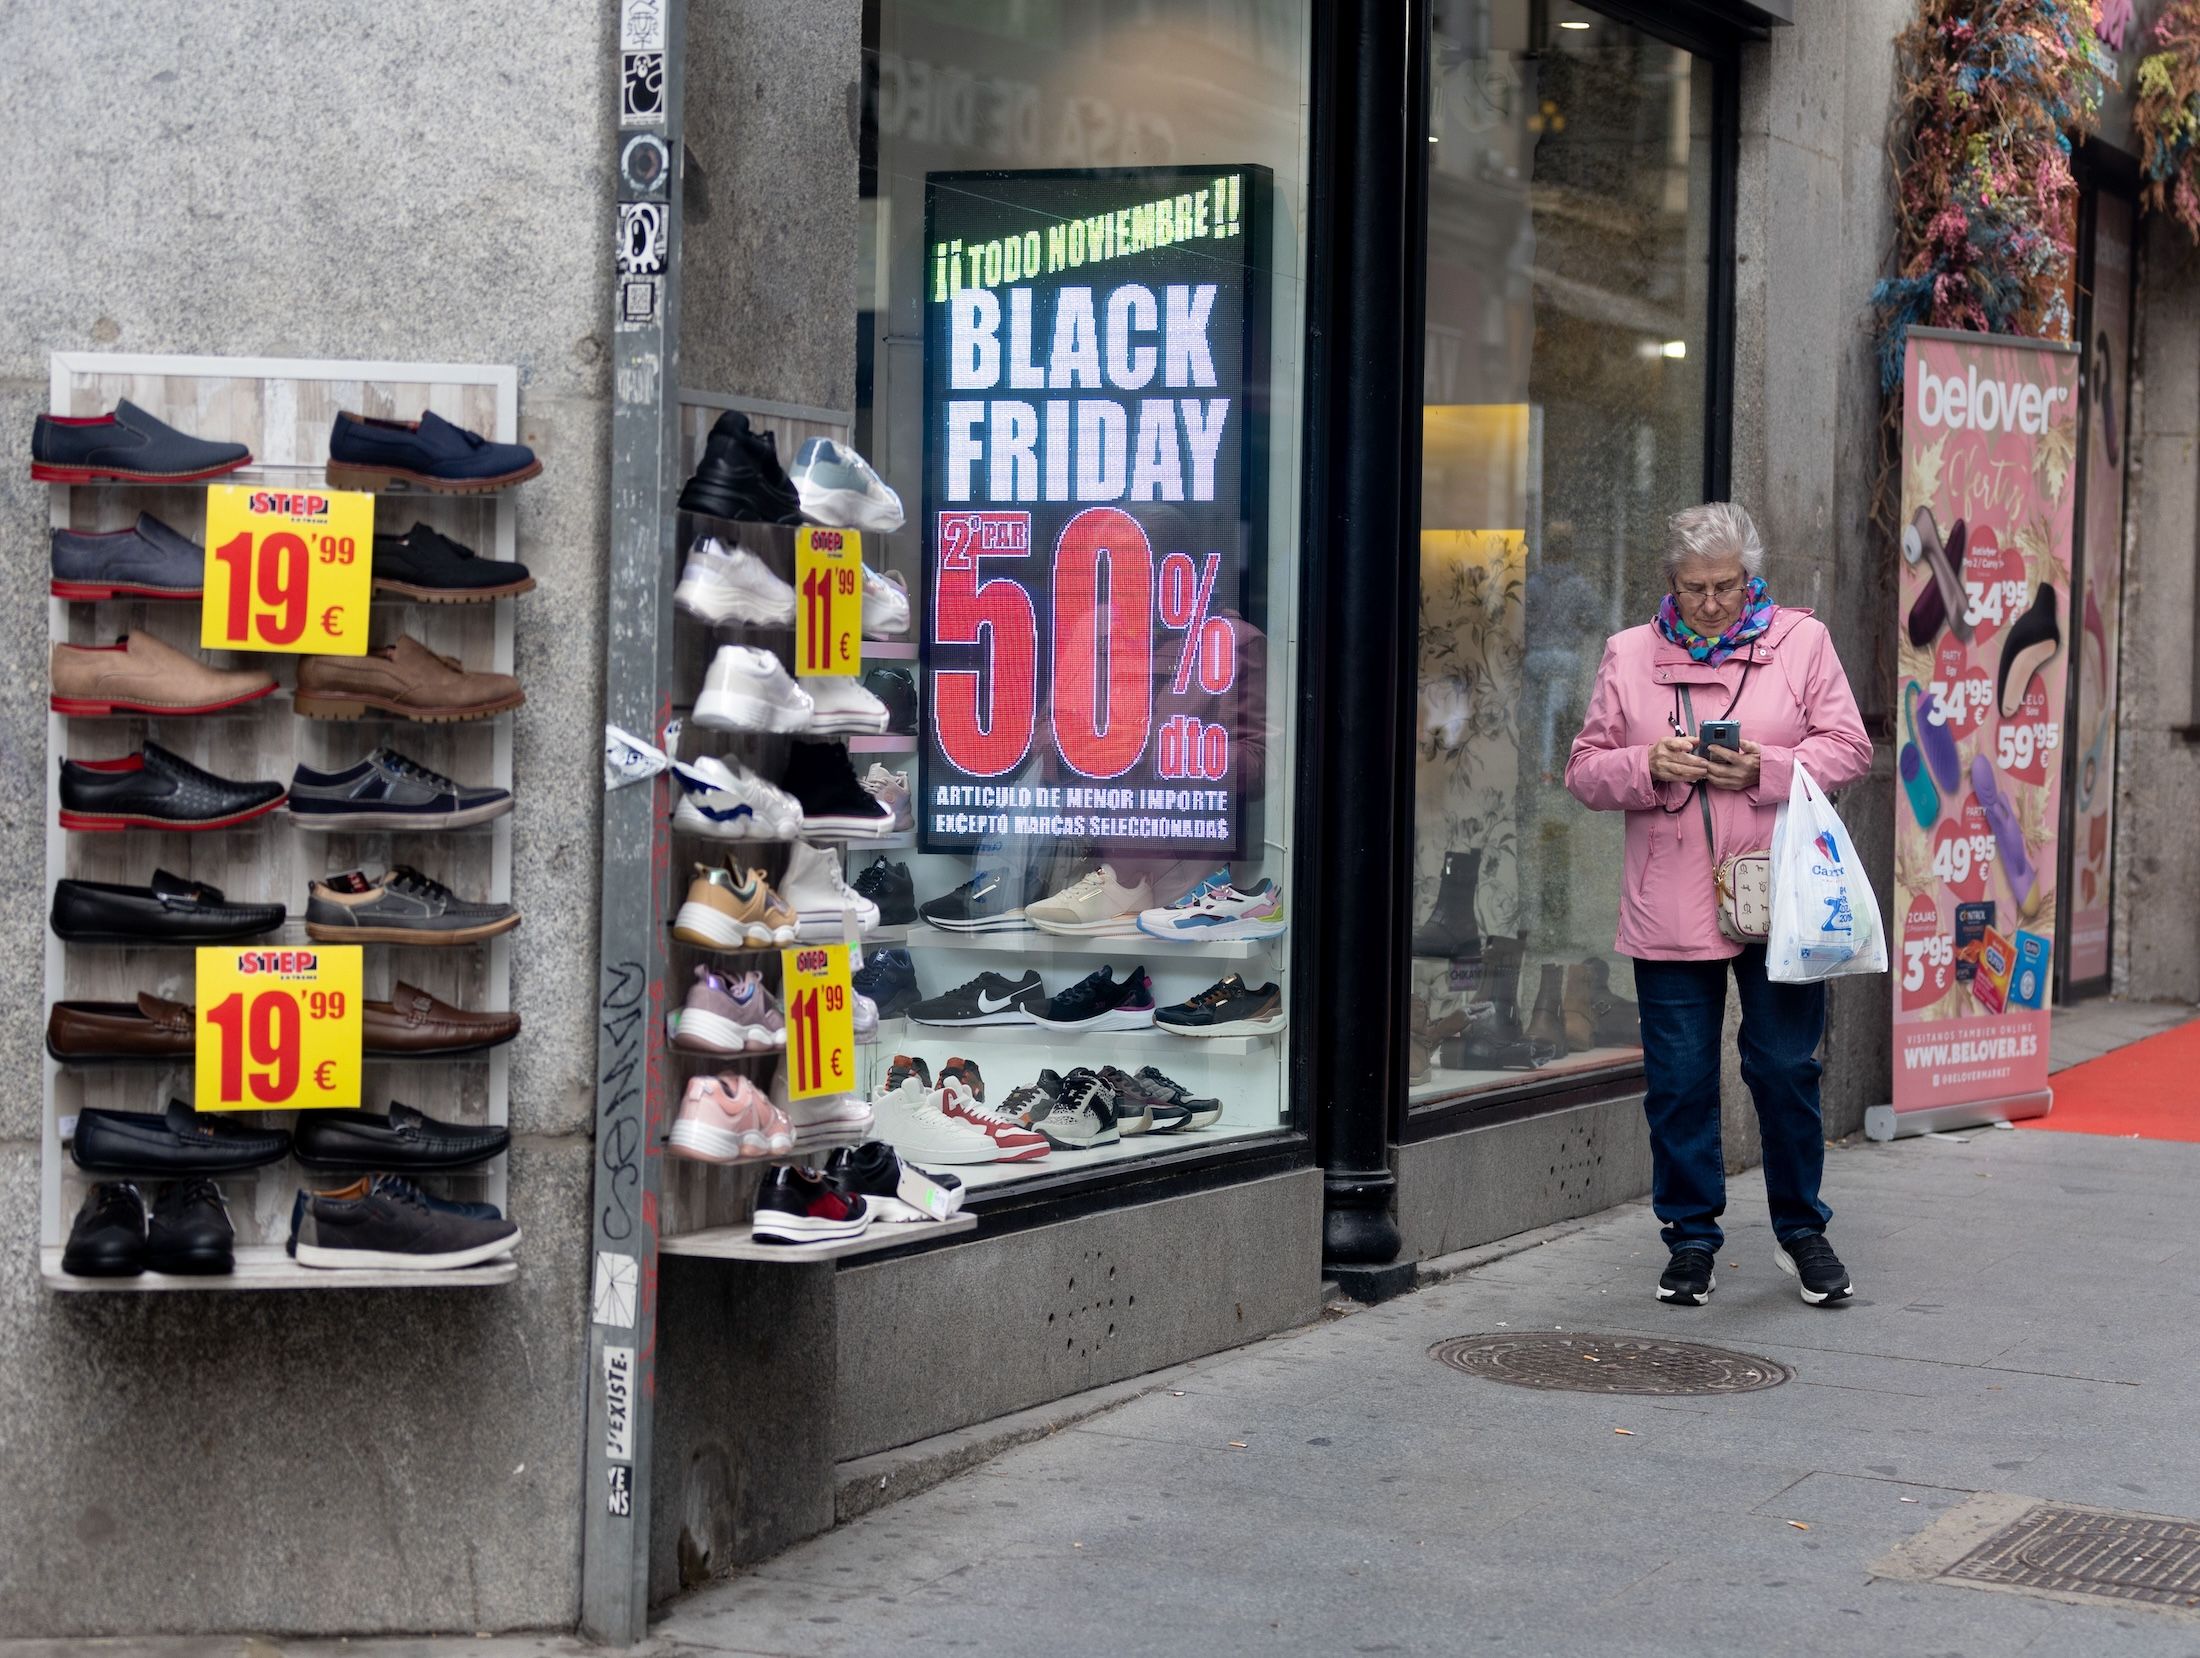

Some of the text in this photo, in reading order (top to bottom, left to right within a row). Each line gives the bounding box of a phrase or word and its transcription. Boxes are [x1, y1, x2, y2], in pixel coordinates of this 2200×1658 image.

[948, 284, 1218, 390] BLACK
[1918, 360, 2058, 435] belover
[945, 399, 1231, 502] FRIDAY
[252, 492, 328, 515] STEP
[811, 531, 843, 551] STEP
[982, 521, 1028, 549] PAR
[321, 606, 345, 636] €
[840, 633, 850, 660] €
[1974, 706, 1984, 726] €
[1158, 714, 1229, 780] dto
[2040, 750, 2049, 768] €
[936, 786, 1227, 812] ARTICULO DE MENOR IMPORTE
[1966, 806, 1987, 817] PARTY
[936, 812, 1229, 839] EXCEPTO MARCAS SELECCIONADAS
[1979, 862, 1989, 881] €
[1908, 911, 1937, 923] 2 CAJAS
[239, 952, 317, 974] STEP
[797, 950, 828, 972] STEP
[1936, 967, 1946, 989] €
[1907, 1030, 1955, 1045] VISITANOS
[831, 1048, 843, 1076] €
[1904, 1035, 2037, 1070] WWW.BELOVER.ES
[314, 1060, 337, 1090] €
